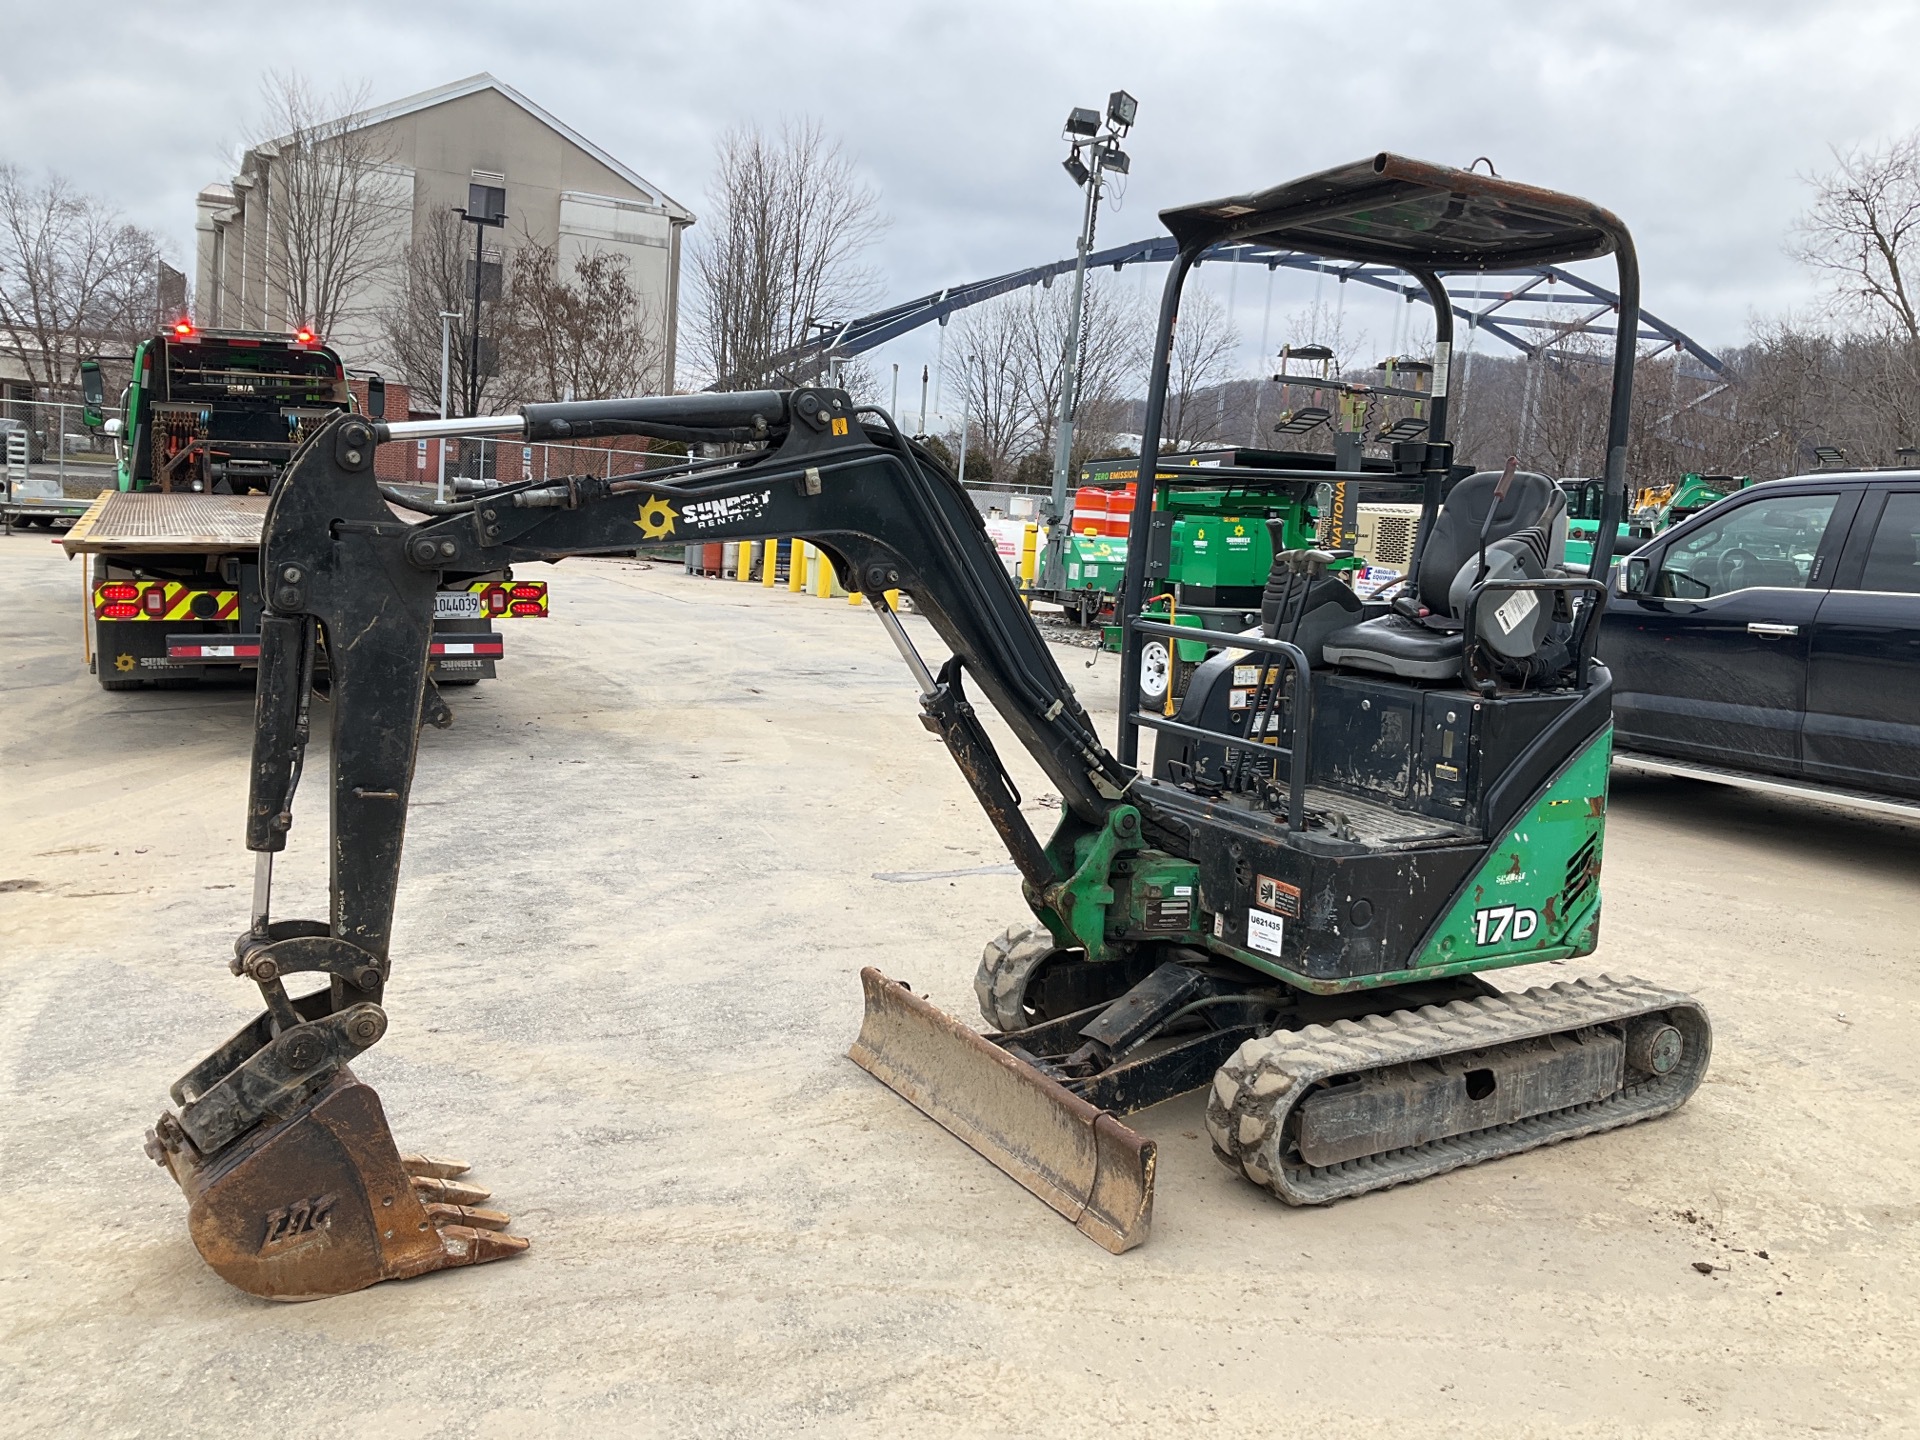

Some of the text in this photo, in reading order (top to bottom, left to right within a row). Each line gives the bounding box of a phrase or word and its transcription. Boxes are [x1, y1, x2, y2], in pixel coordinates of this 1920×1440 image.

[1094, 472, 1109, 480] ZERO
[698, 512, 762, 529] RENTAS
[1331, 481, 1346, 548] NATIONA
[434, 598, 478, 611] 1044039
[1251, 915, 1281, 930] U621435
[1475, 904, 1538, 947] 17D
